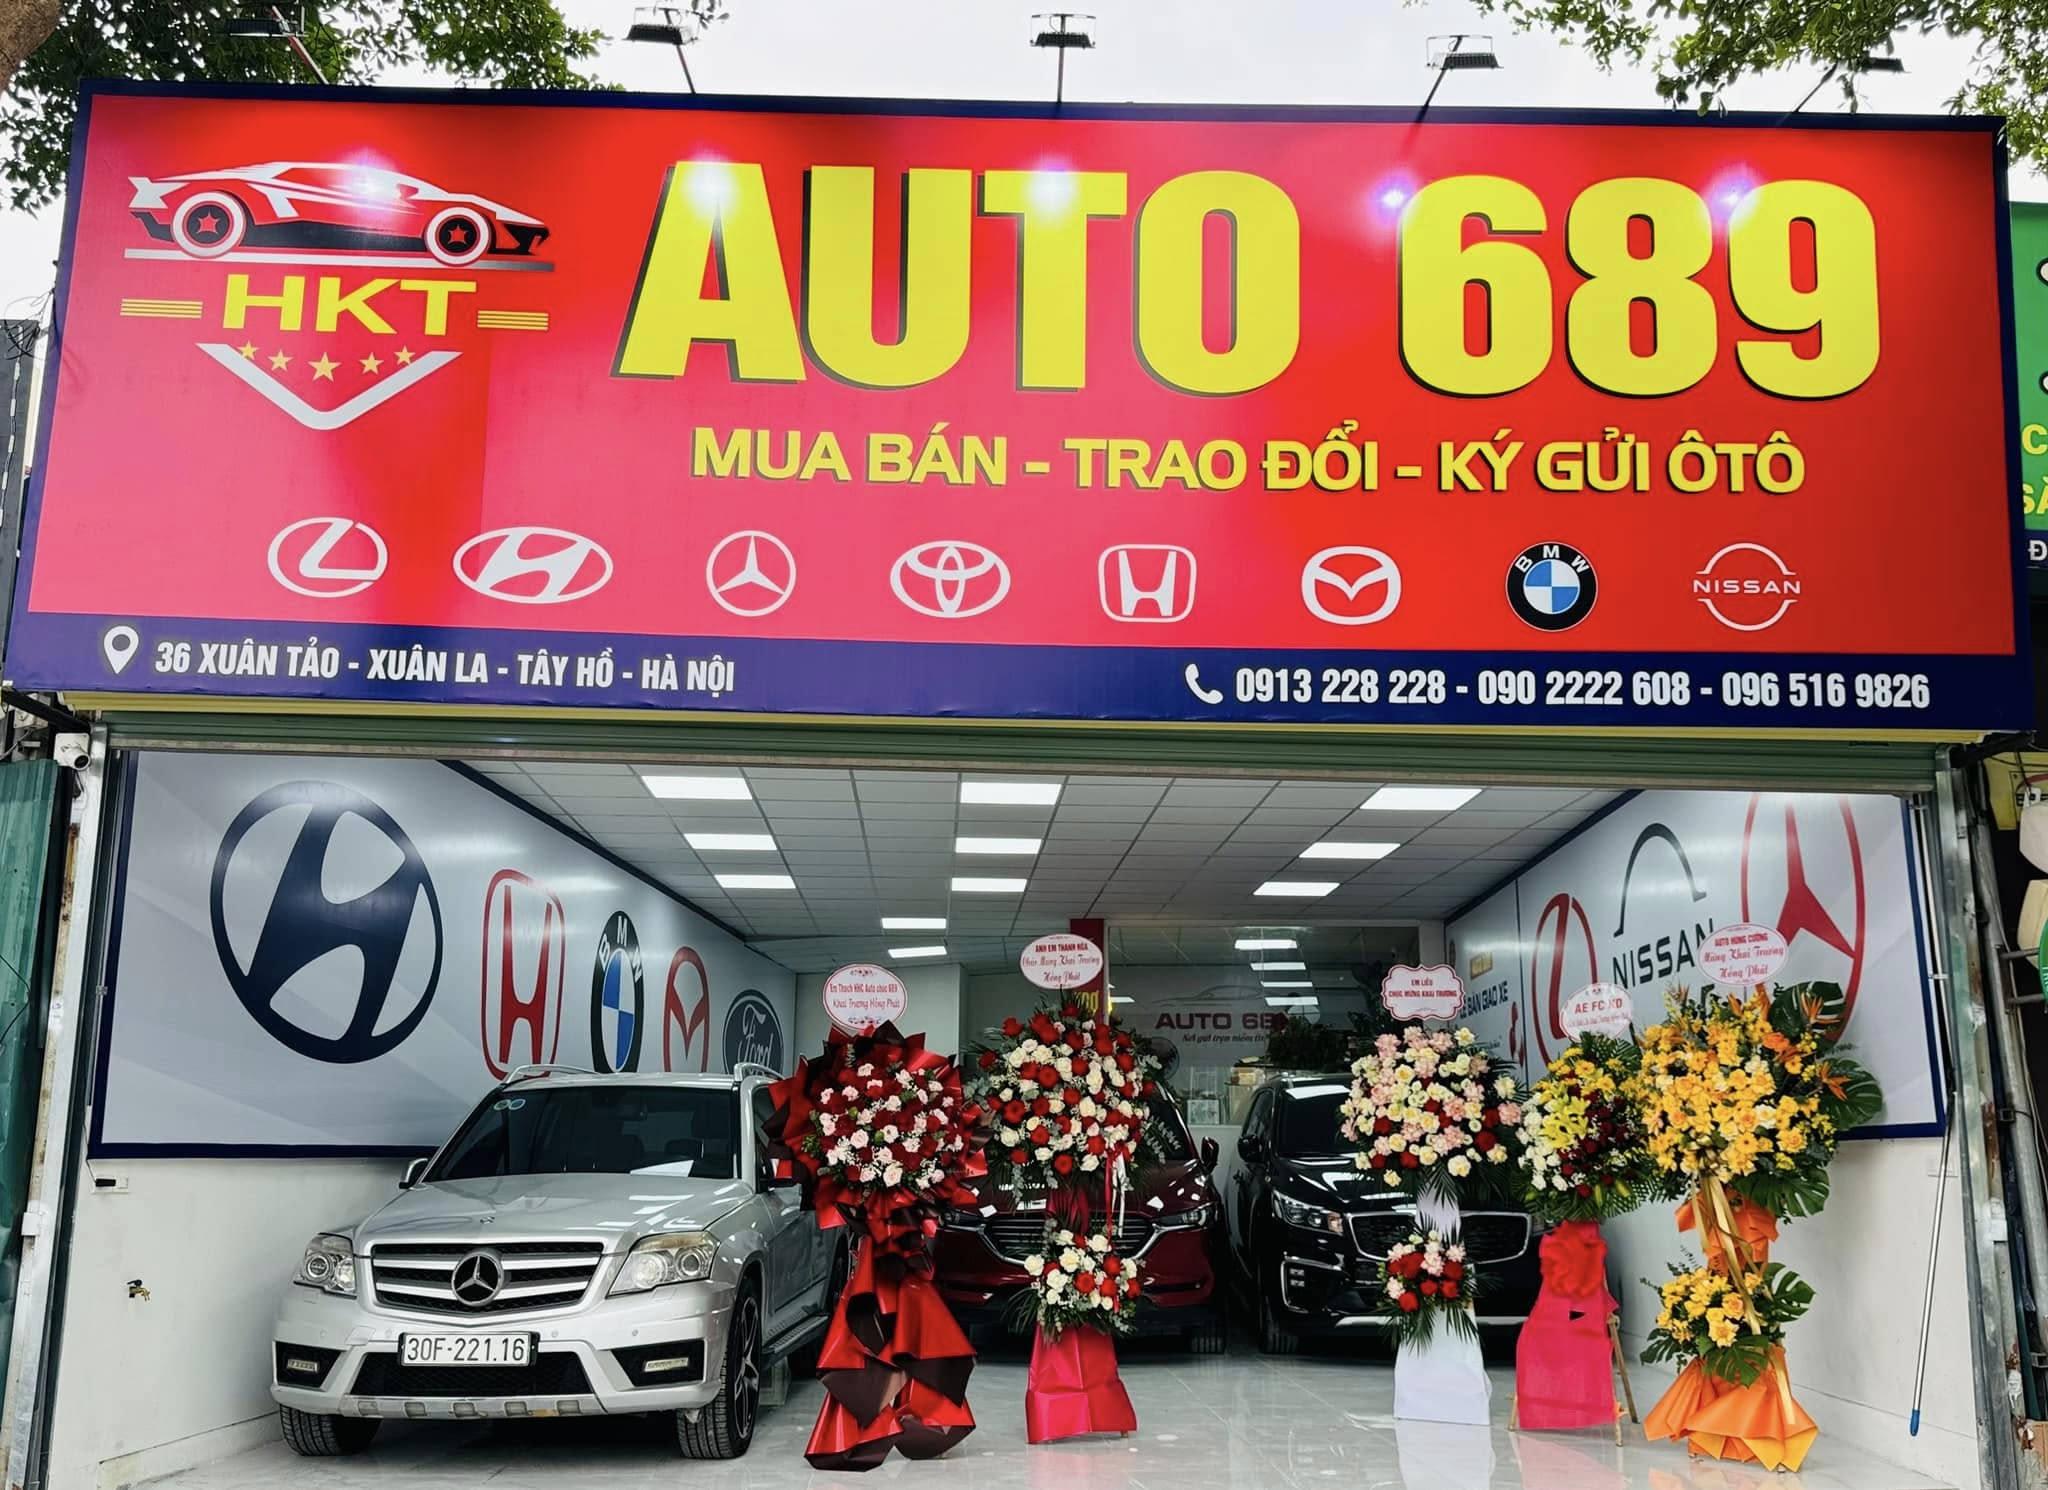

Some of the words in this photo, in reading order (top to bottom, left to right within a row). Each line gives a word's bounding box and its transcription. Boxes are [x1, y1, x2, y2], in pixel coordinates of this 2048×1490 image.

[222, 273, 477, 336] HKT
[618, 160, 1301, 396] AUTO
[1399, 174, 1881, 401] 689
[691, 427, 852, 482] MUA
[866, 422, 1007, 486] BÁN
[1063, 438, 1248, 491] TRAO
[1262, 419, 1379, 492] ĐỔI
[1438, 428, 1525, 492] KÝ
[1535, 426, 1650, 493] GỬI
[1667, 429, 1806, 494] ÔTÔ
[1514, 545, 1590, 573] BMW
[1693, 579, 1801, 595] NISSAN
[155, 642, 191, 673] 36
[197, 638, 277, 676] XUÂN
[286, 636, 339, 678] TẢO
[366, 644, 448, 682] XUÂN
[455, 652, 489, 683] LA
[517, 649, 568, 687] TÂY
[576, 647, 614, 688] HỒ
[641, 654, 679, 691] HÀ
[686, 655, 735, 698] NỘI
[1236, 668, 1312, 703] 0913
[1321, 669, 1379, 704] 228
[1388, 669, 1446, 705] 228
[1478, 669, 1536, 706] 090
[1545, 671, 1624, 706] 2222
[1632, 671, 1691, 706] 608
[1721, 672, 1780, 707] 096
[1788, 672, 1846, 707] 516
[1855, 673, 1930, 708] 9826
[598, 915, 643, 984] BMW
[1612, 917, 1714, 989] NISSAN
[1154, 1012, 1232, 1030] AUTO
[1574, 1003, 1589, 1014] AE
[1591, 1000, 1605, 1011] FC
[407, 1338, 525, 1361] 30F-221.16
